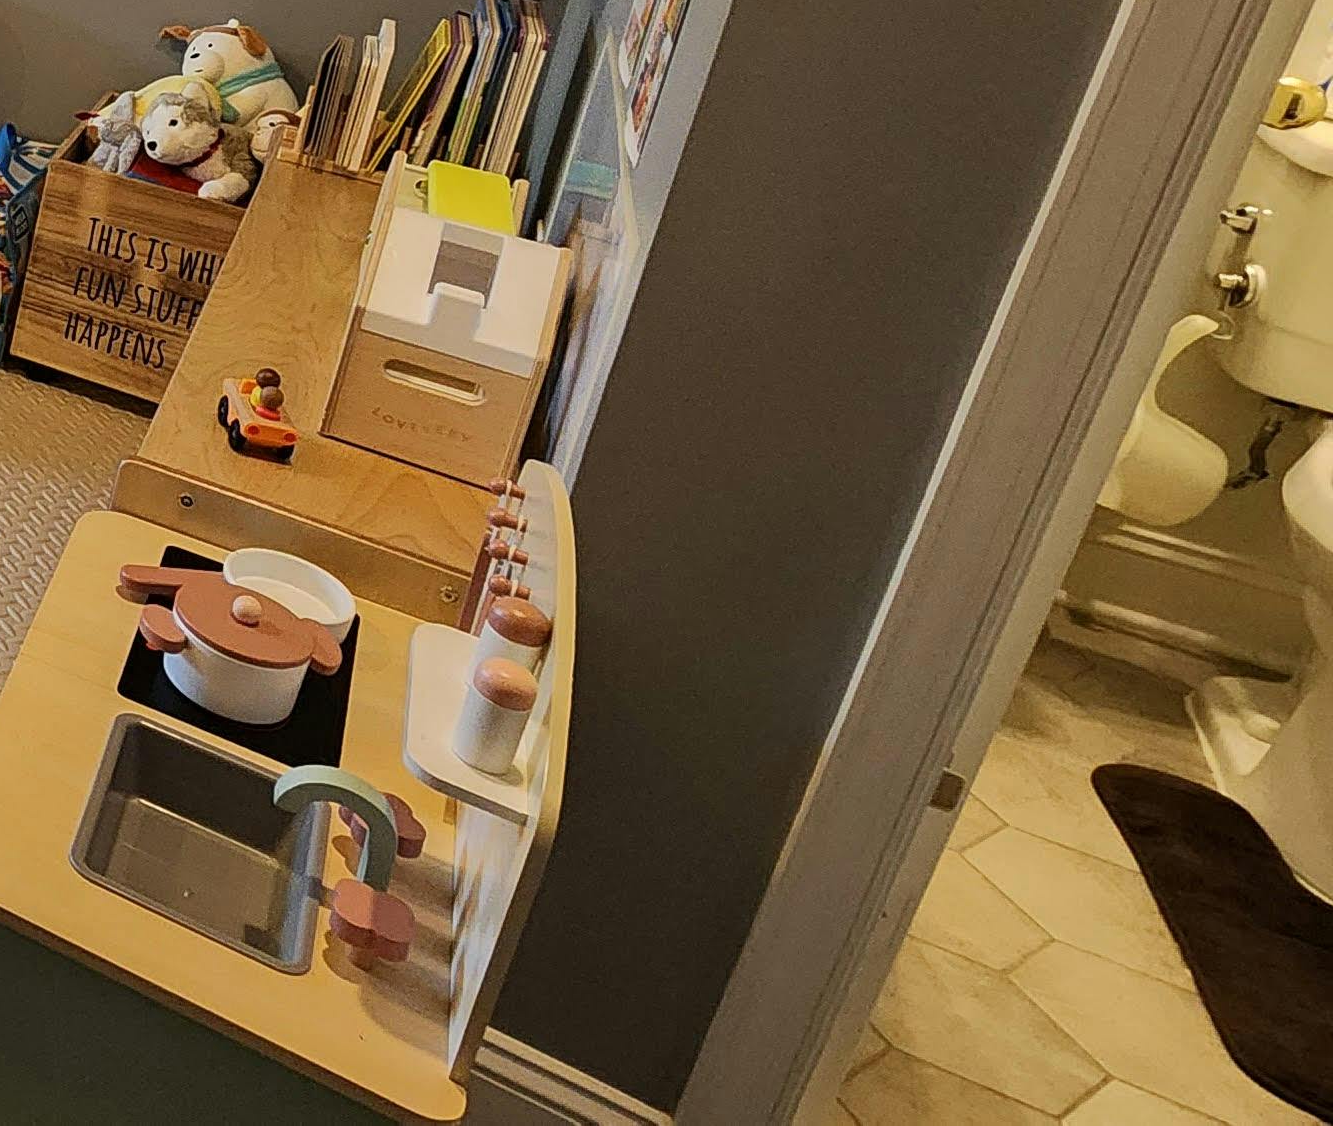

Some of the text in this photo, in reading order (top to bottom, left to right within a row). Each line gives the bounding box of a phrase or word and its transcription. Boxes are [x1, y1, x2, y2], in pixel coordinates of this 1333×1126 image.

[87, 217, 138, 263] THIS
[144, 237, 171, 273] IS
[73, 266, 126, 308] FUN
[64, 311, 167, 369] HAPPENS
